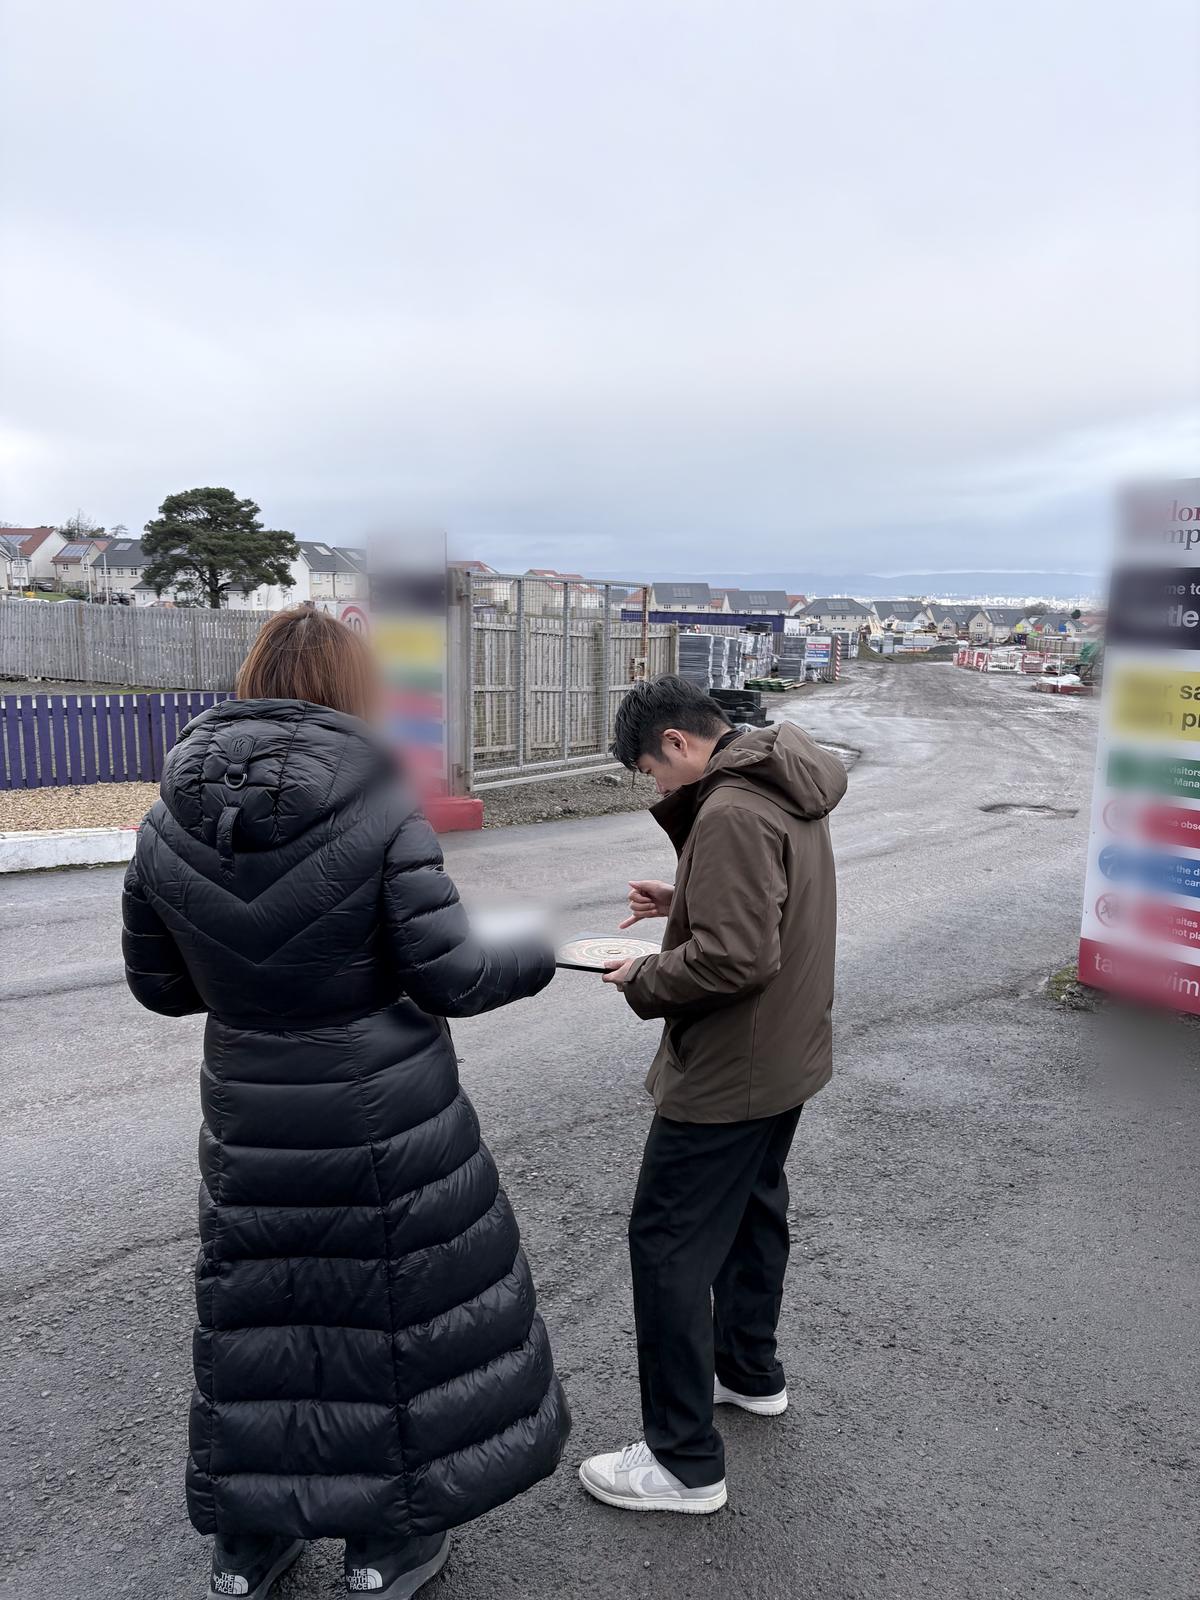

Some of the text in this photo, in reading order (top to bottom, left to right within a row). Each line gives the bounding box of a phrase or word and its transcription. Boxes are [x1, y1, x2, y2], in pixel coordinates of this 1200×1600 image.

[221, 1571, 234, 1581] THE
[353, 1568, 367, 1576] THE
[215, 1582, 233, 1595] FACE
[350, 1582, 367, 1590] FACE
